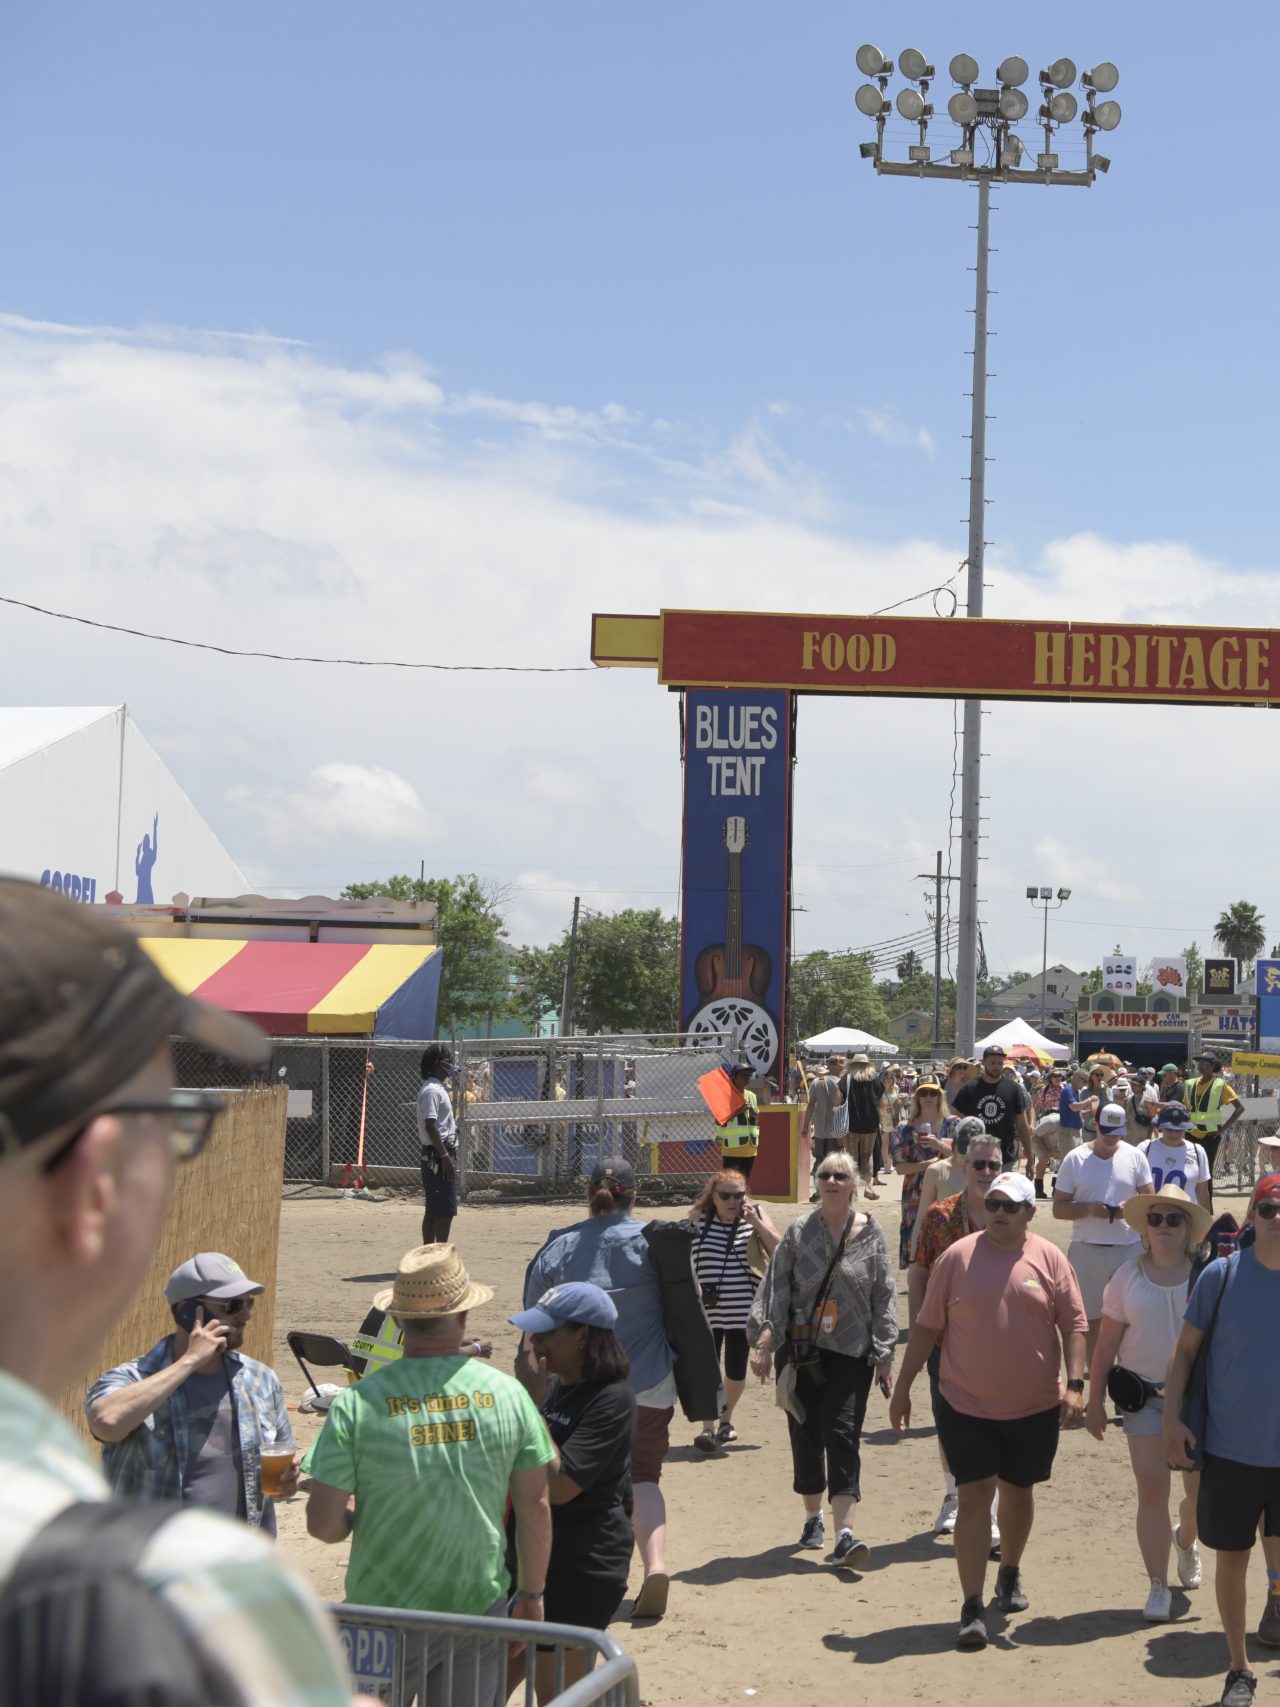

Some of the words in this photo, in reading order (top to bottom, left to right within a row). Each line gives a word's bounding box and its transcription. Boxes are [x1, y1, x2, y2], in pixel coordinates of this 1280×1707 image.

[801, 631, 897, 672] FOOD
[1033, 631, 1270, 691] HERITAGE
[695, 705, 778, 750] BLUES
[706, 755, 766, 796] TENT
[1092, 1013, 1159, 1028] T-SHIRTS
[1166, 1013, 1180, 1021] CAN
[1218, 1016, 1256, 1031] HATS
[386, 1394, 421, 1417] It's
[423, 1391, 469, 1412] time
[472, 1389, 494, 1409] to
[410, 1419, 476, 1447] SHINE!
